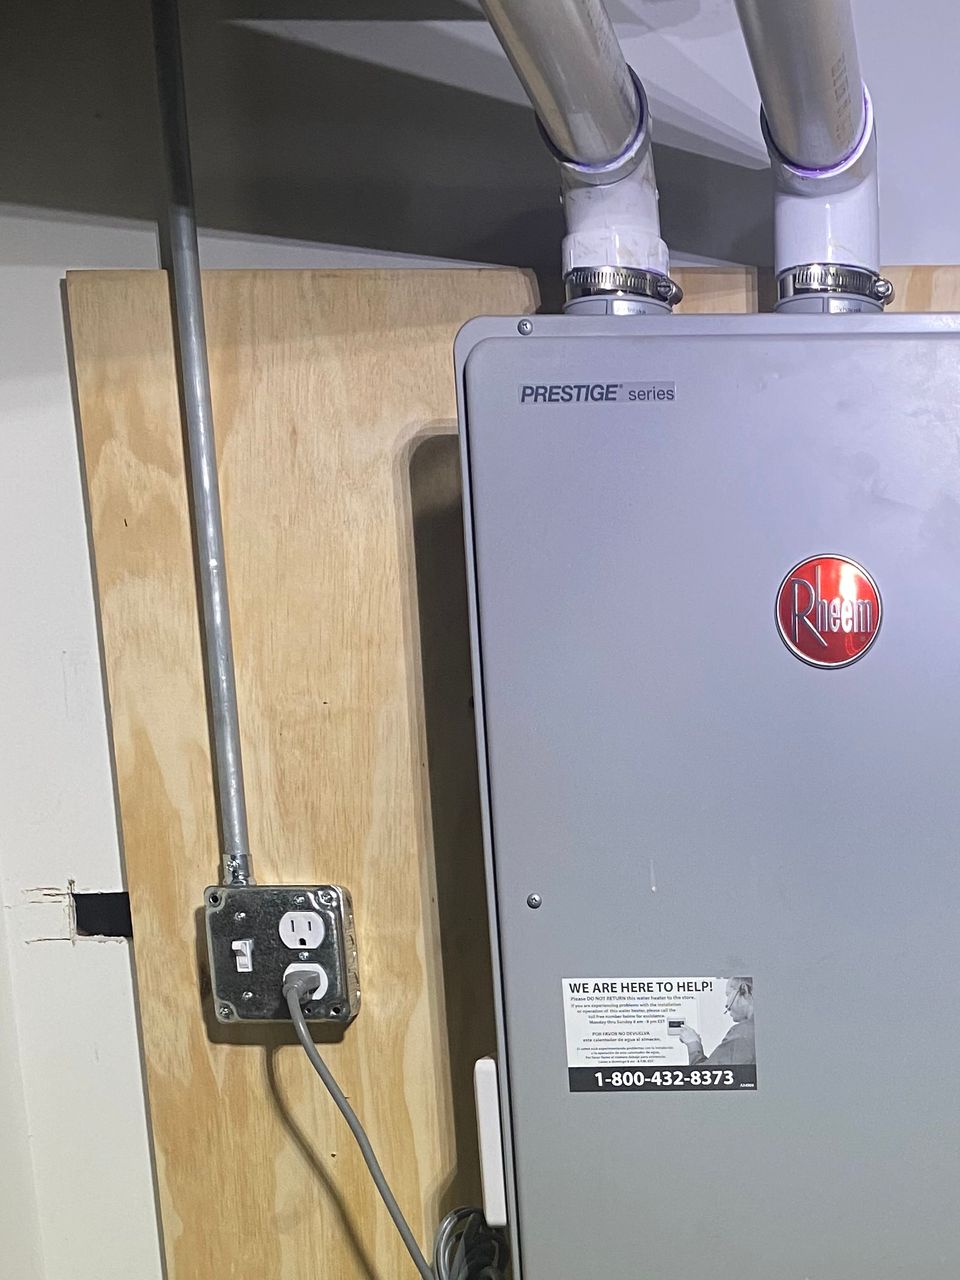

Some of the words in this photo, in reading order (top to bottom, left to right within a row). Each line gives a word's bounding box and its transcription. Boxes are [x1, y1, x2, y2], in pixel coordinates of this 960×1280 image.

[520, 383, 619, 403] PRESTIGE
[628, 386, 675, 401] series
[790, 564, 873, 648] Rheem
[568, 982, 589, 994] WE
[592, 982, 618, 993] ARE
[620, 982, 654, 993] HERE
[656, 981, 674, 992] TO
[677, 981, 713, 992] HELP!
[595, 1070, 734, 1087] 1-800-432-8373
